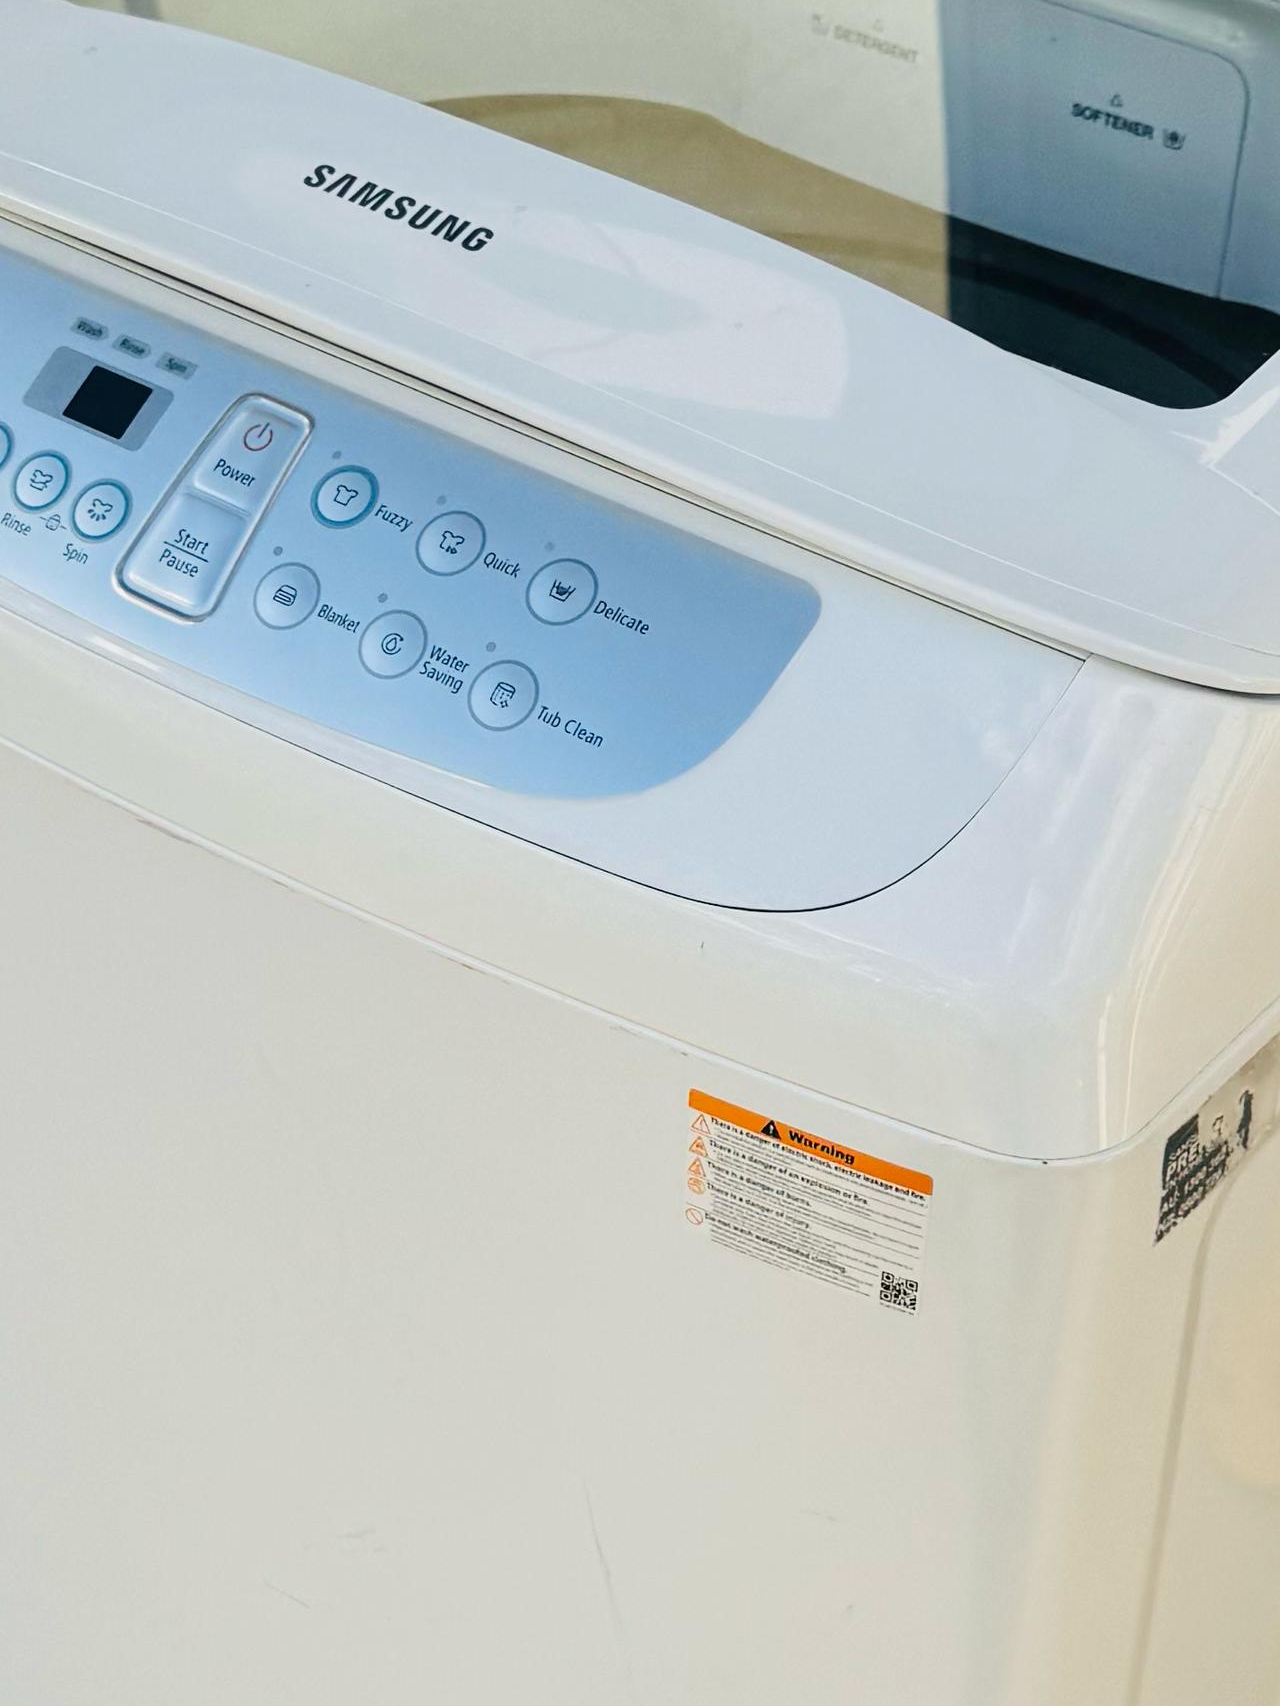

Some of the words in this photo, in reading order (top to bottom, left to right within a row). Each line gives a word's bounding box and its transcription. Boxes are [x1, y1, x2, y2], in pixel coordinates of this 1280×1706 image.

[1071, 102, 1155, 141] SOFTENER
[303, 164, 495, 252] SAMSUNG
[77, 320, 104, 337] Wash
[119, 338, 146, 356] Rinse
[166, 357, 188, 374] Spin
[213, 458, 256, 488] Power
[0, 512, 32, 537] Rinse
[374, 504, 414, 533] Fuzzy
[62, 544, 89, 566] Spin
[174, 528, 210, 555] Start
[158, 549, 199, 578] Pause
[483, 551, 521, 580] Quick
[317, 604, 361, 634] Blanket
[593, 599, 650, 635] Delicate
[429, 644, 470, 674] Water
[419, 661, 465, 695] Saving
[535, 704, 563, 730] Tub
[564, 718, 605, 749] Clean
[788, 1129, 856, 1166] Warning
